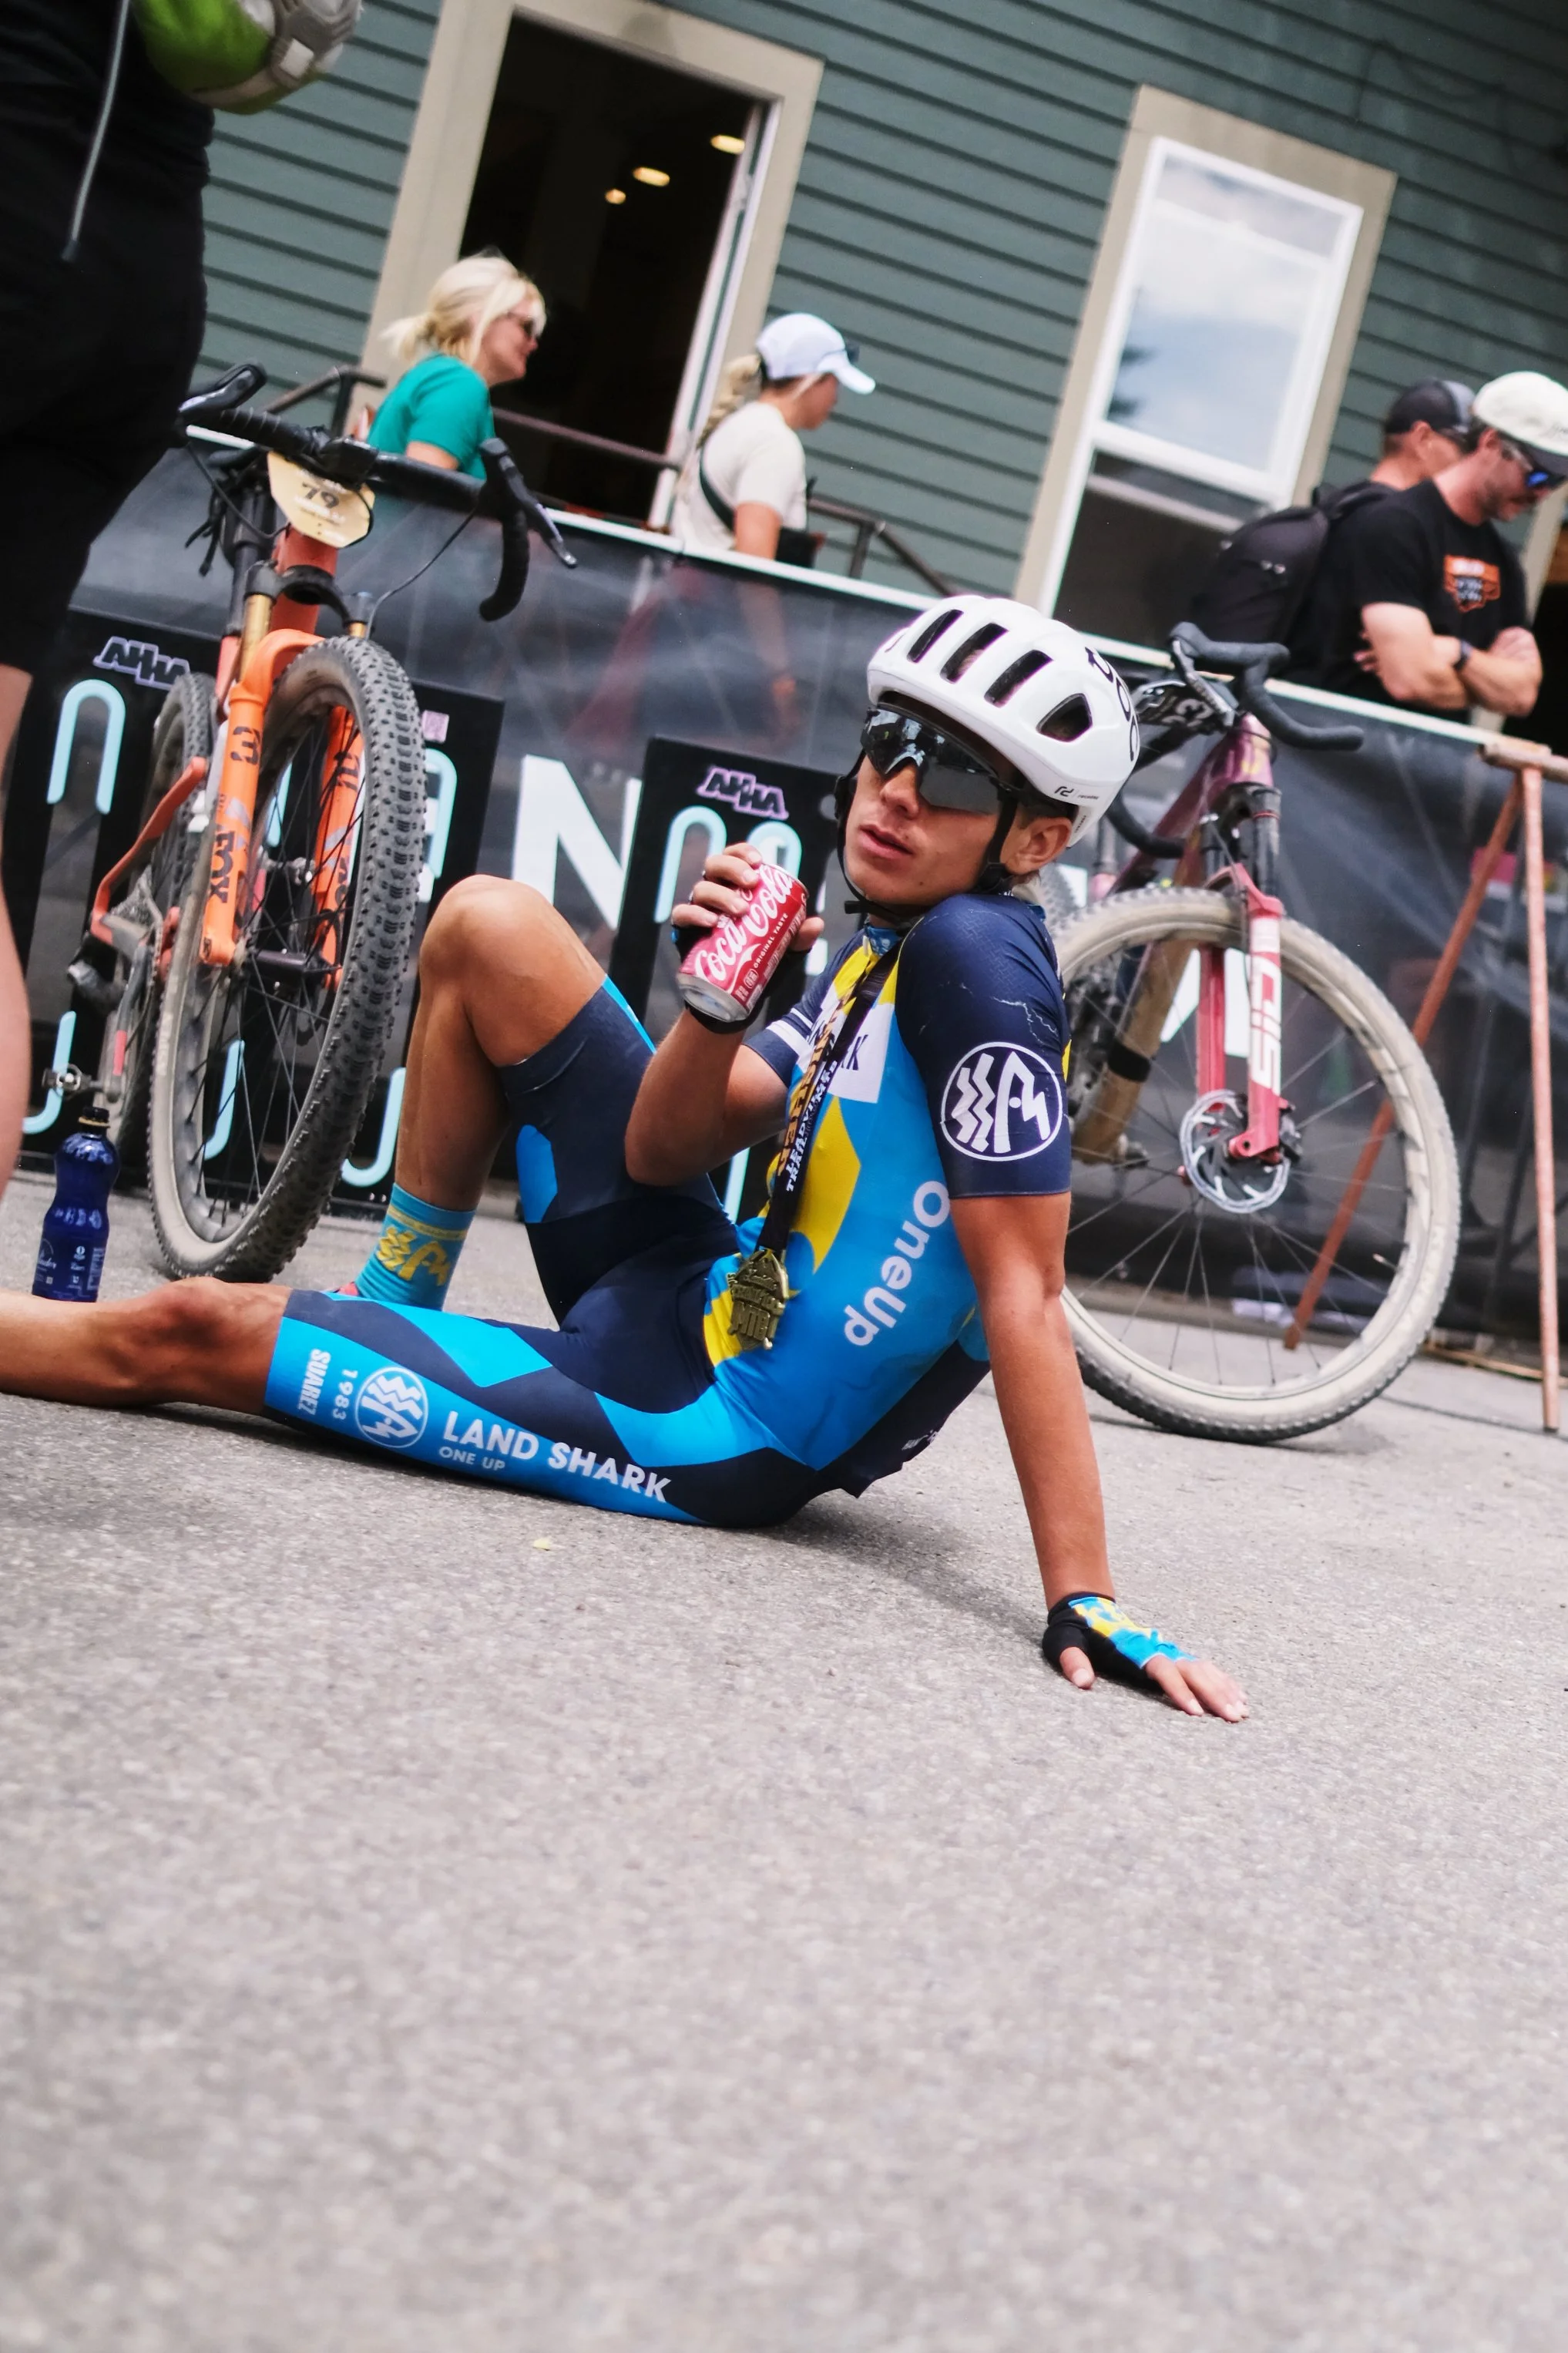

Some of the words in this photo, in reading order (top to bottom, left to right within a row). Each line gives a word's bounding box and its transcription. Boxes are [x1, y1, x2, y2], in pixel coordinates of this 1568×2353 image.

[301, 482, 339, 509] 79
[208, 830, 235, 904] FOX
[754, 935, 775, 969] ORIGINAL
[774, 913, 788, 936] TASTE
[844, 1181, 950, 1346] OneUp
[297, 1348, 331, 1416] SUAREZ
[333, 1369, 358, 1420] 1983
[438, 1446, 476, 1465] ONE
[482, 1457, 505, 1471] UP
[443, 1410, 539, 1461] LAND
[548, 1442, 671, 1503] SHARK
